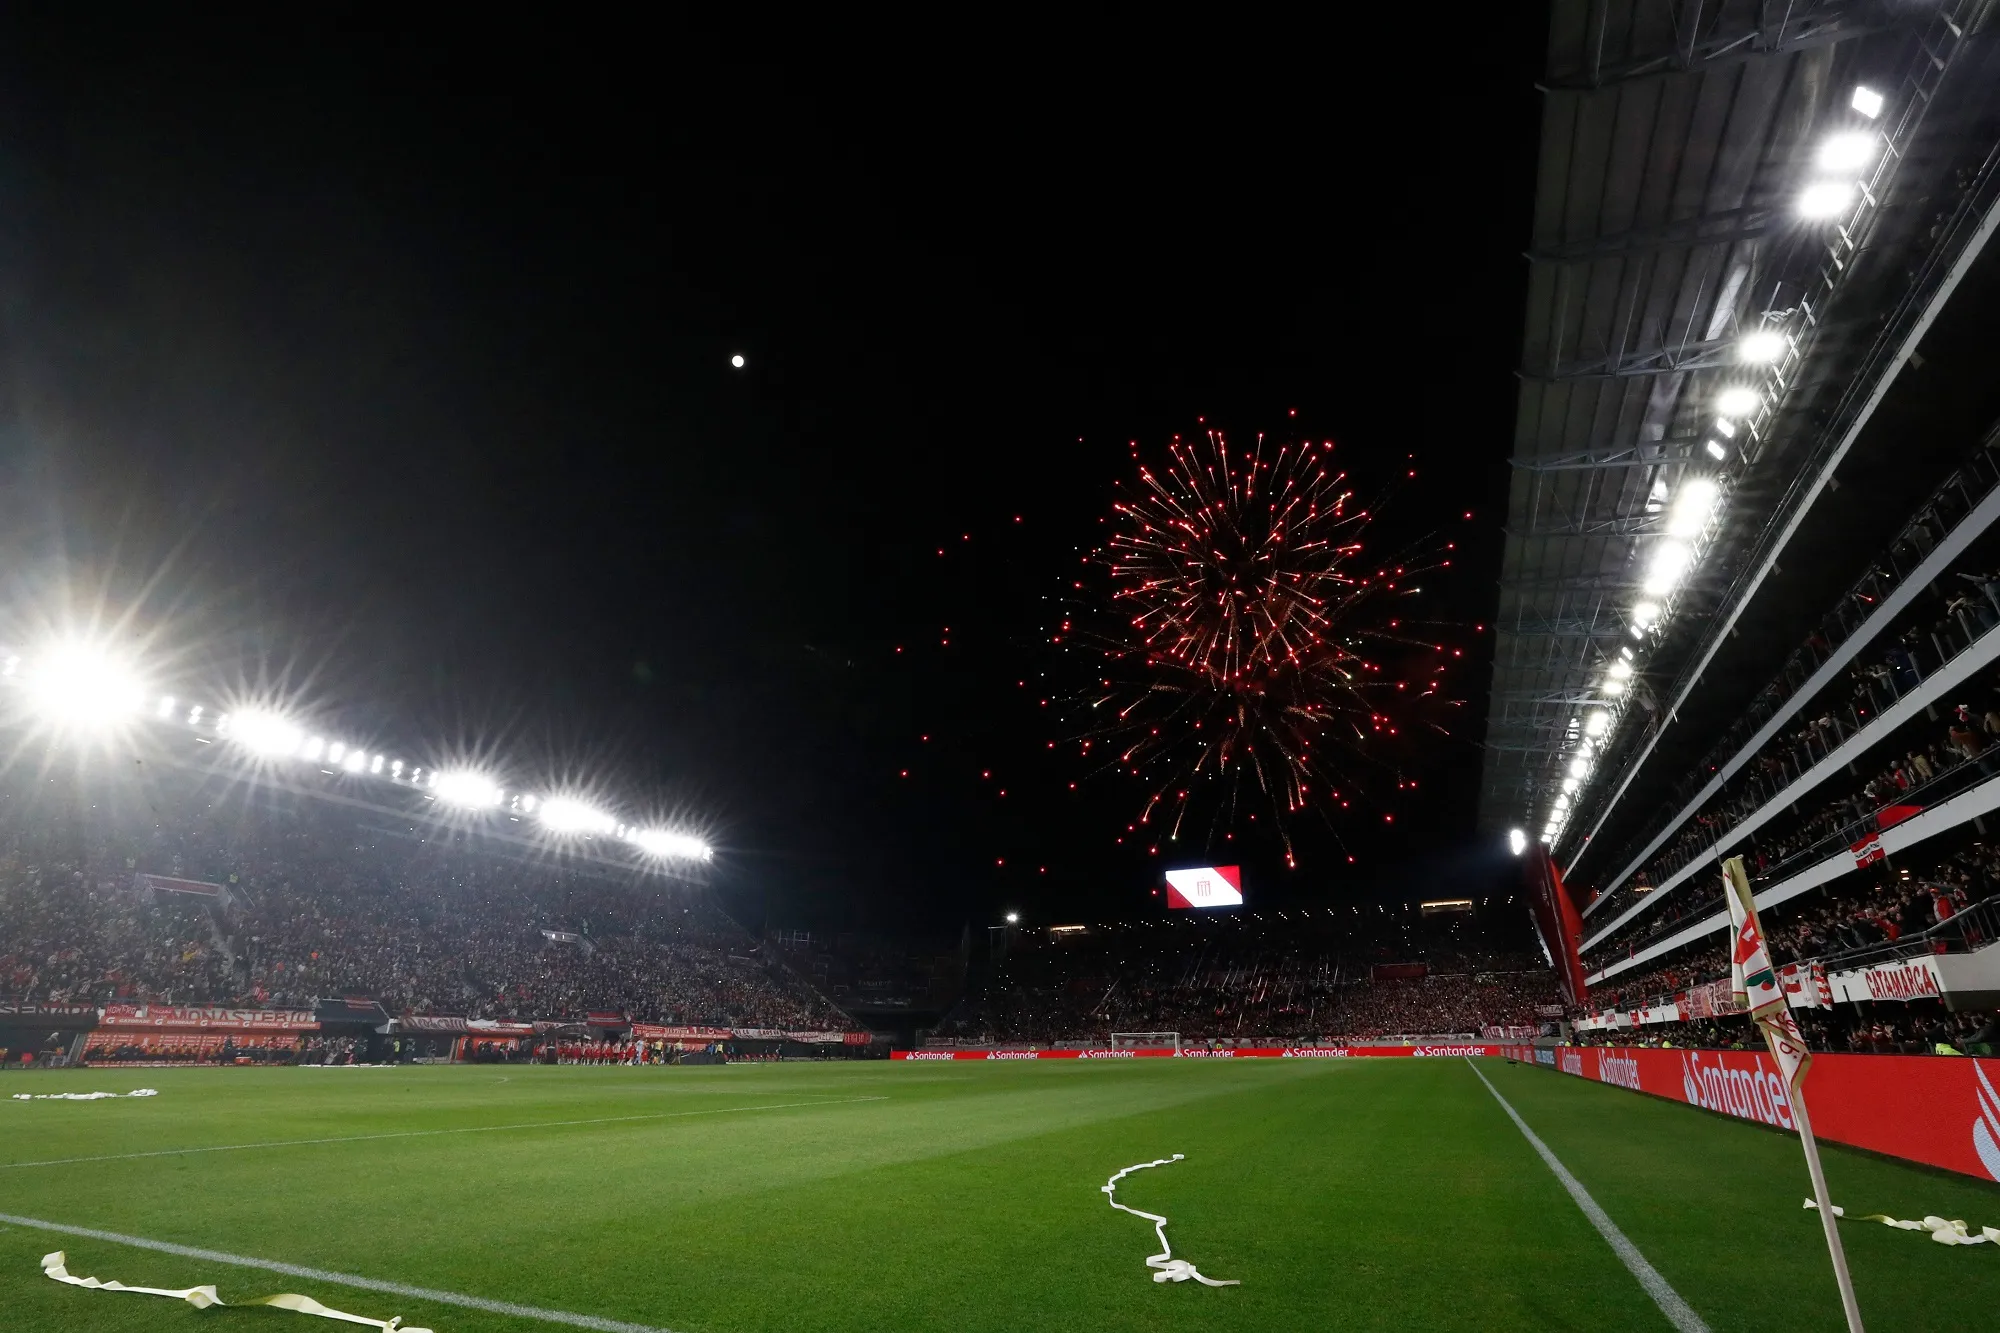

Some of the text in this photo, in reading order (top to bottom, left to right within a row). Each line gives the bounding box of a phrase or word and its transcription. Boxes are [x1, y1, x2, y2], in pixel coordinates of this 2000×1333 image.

[1865, 964, 1938, 999] CATAMARCA
[914, 1052, 955, 1060] Santander
[995, 1051, 1039, 1060] Santander
[1088, 1050, 1135, 1058] Santander
[1184, 1049, 1235, 1057] Santander
[1293, 1048, 1349, 1058] Santander
[1425, 1046, 1486, 1057] Santander
[1601, 1049, 1640, 1090] Santander
[1691, 1051, 1800, 1131] Santander
